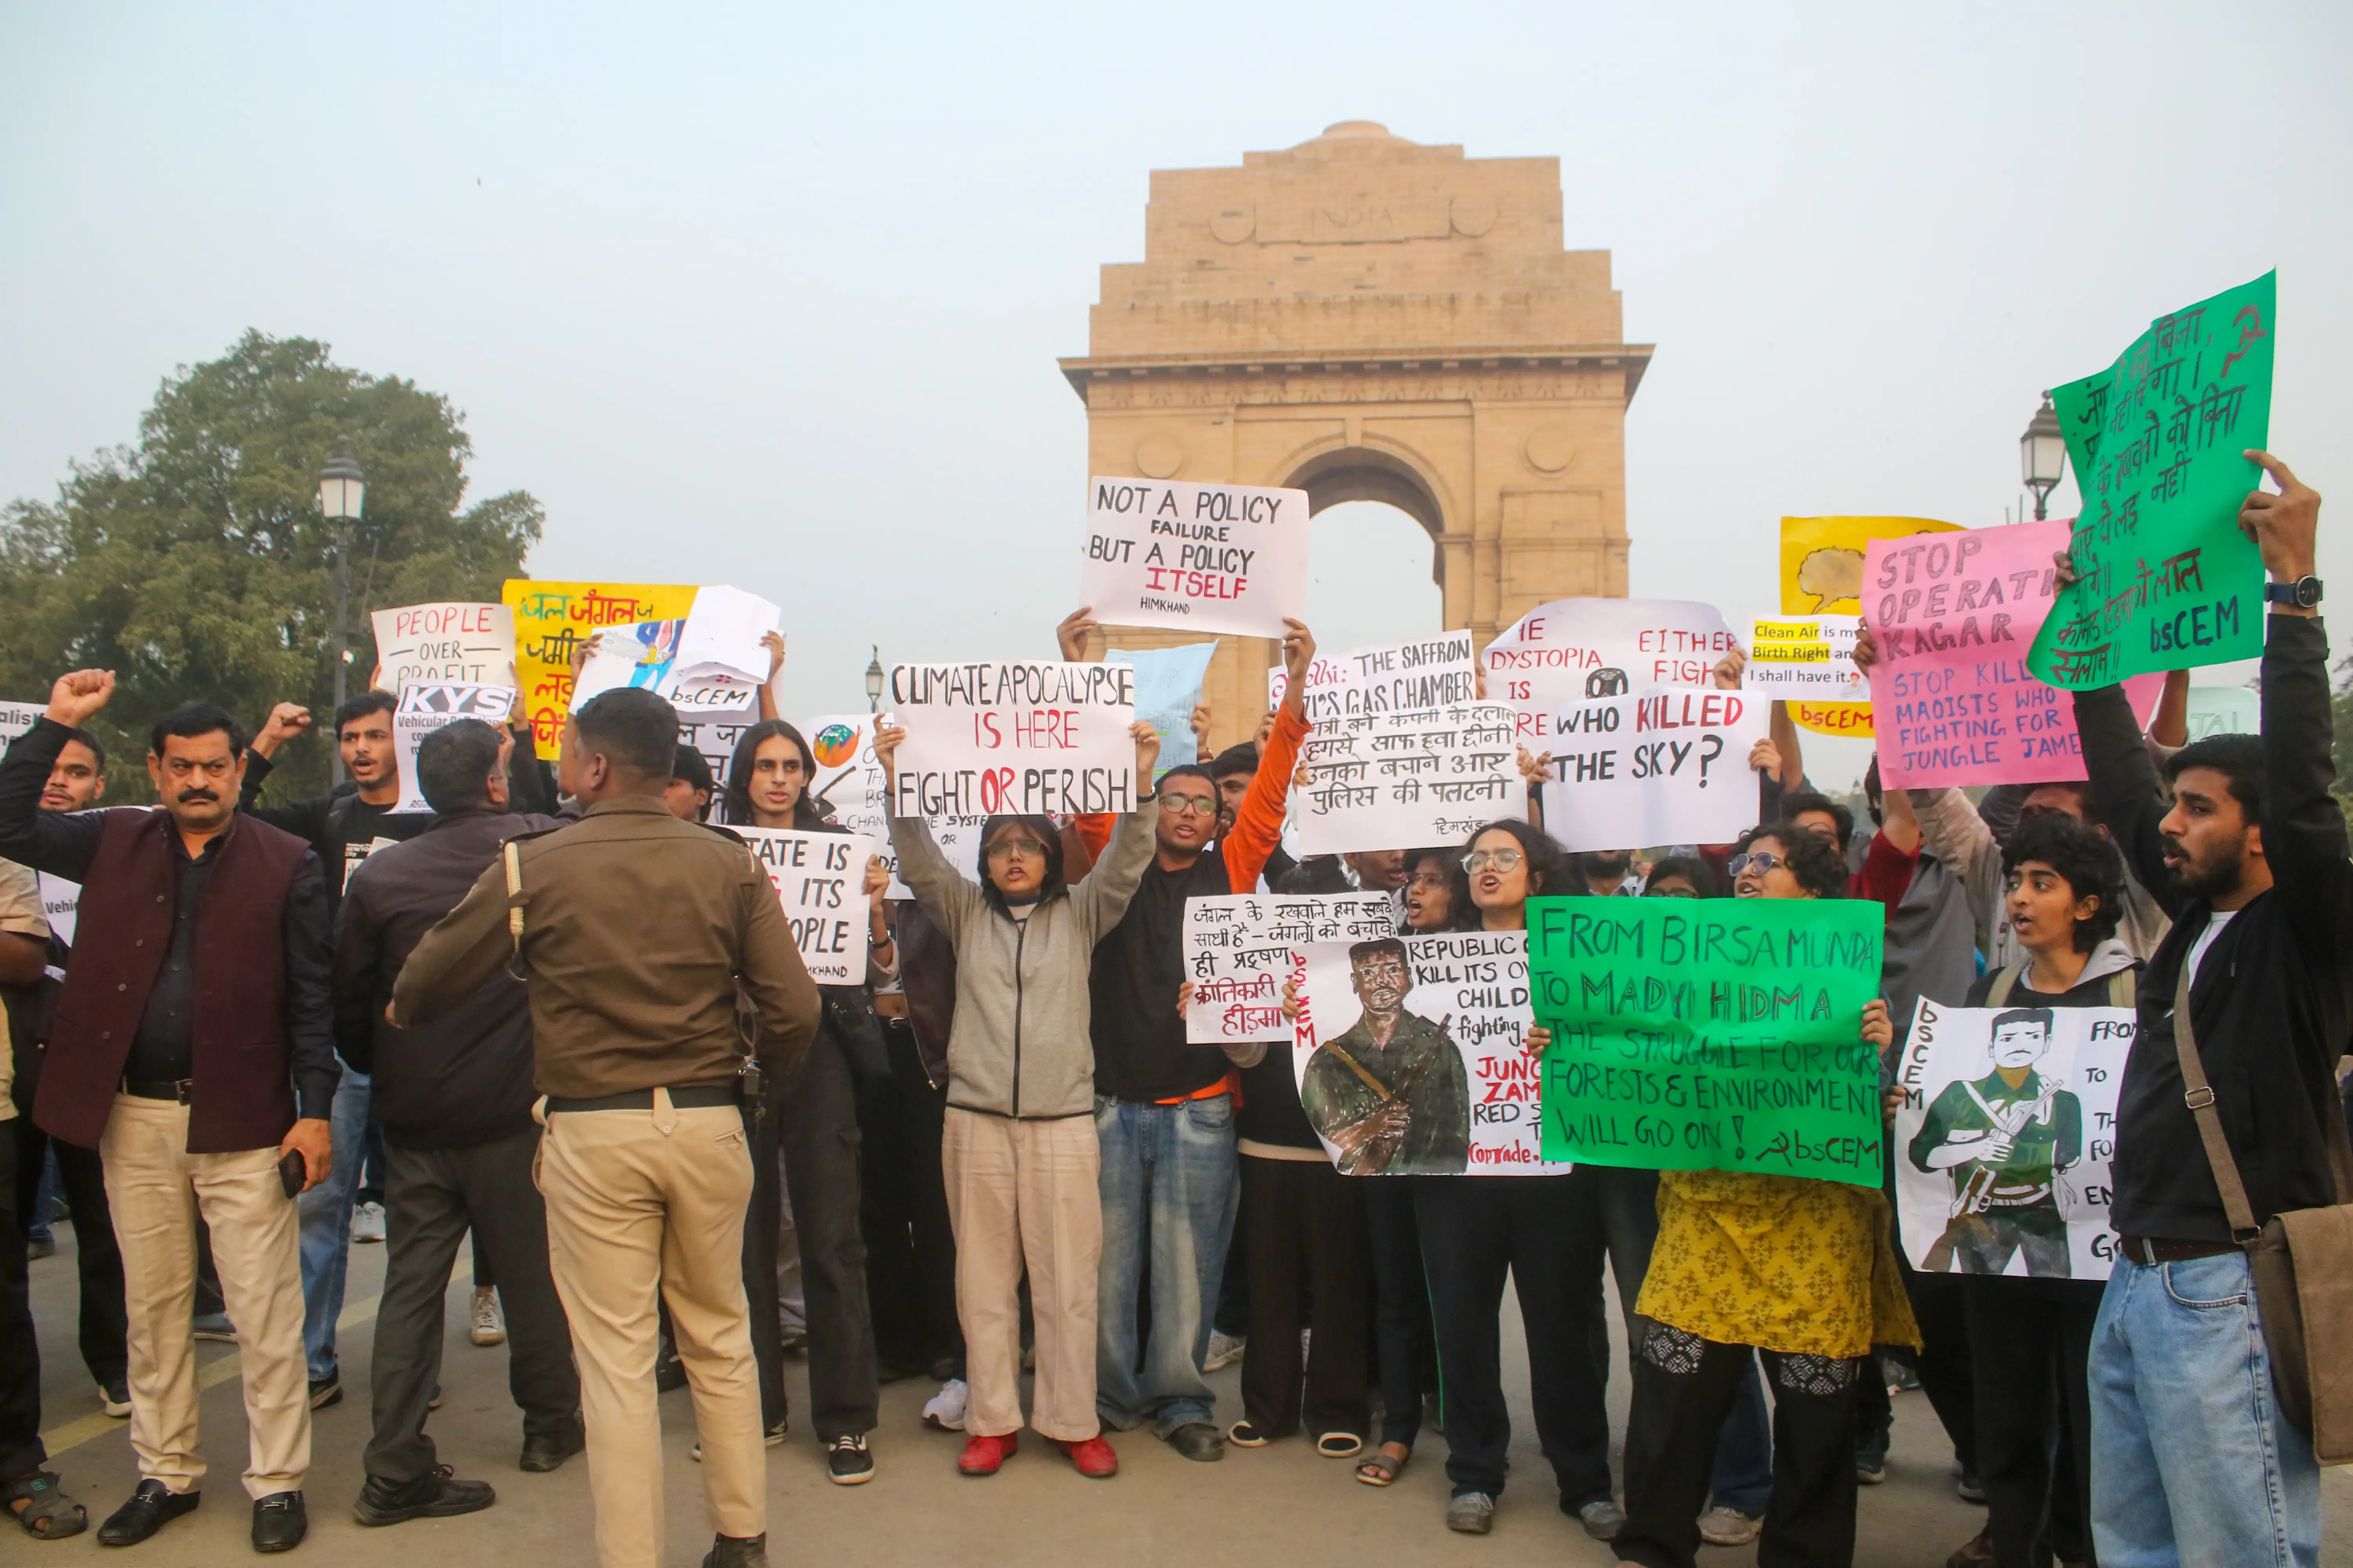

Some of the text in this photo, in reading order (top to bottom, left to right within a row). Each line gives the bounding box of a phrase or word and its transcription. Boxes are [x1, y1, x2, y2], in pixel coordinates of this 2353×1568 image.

[1097, 484, 1282, 524] NOT A POLICY
[1150, 519, 1230, 542] FAILURE
[1089, 535, 1255, 576] BUT A POLICY
[1877, 536, 1982, 589] STOP
[1145, 567, 1247, 600] ITSELF
[1878, 568, 2055, 628] OPERATI
[522, 593, 573, 621] जल
[570, 589, 640, 625] जंगल
[1140, 596, 1190, 615] HIMKHAND
[396, 606, 494, 638] PEOPLE
[1755, 625, 1794, 638] Clean
[1799, 627, 1819, 638] Air
[1824, 626, 1835, 637] is
[1883, 612, 2015, 661] KAGAR
[2150, 595, 2239, 653] bsCEM
[419, 640, 463, 660] OVER
[526, 627, 585, 665] जमी
[1639, 629, 1736, 653] EITHER
[1753, 647, 1852, 661] Birth Right an
[1353, 649, 1397, 678] THE
[1401, 638, 1471, 669] SAFFRON
[1491, 647, 1604, 670] DYSTOPIA
[1654, 660, 1713, 686] FIGH
[892, 664, 1135, 707] CLIMATE APOCALYPSE
[1508, 681, 1531, 700] IS
[1751, 669, 1850, 682] I shall have it.
[1895, 658, 2035, 698] STOP KILL
[402, 685, 509, 717] KYS
[669, 685, 748, 705] bsCEM
[1346, 685, 1389, 715] GAS
[1393, 671, 1474, 710] CHAMBER
[1896, 686, 2056, 725] MAOISTS WHO
[398, 715, 448, 728] Vehicular
[975, 709, 1080, 749] IS HERE
[1346, 712, 1380, 732] बने
[1388, 708, 1441, 728] कंपनी
[1447, 706, 1469, 725] के
[1556, 694, 1744, 735] WHO KILLED
[1800, 705, 1873, 729] bsCEM
[1900, 709, 2062, 747] FIGHTING FOR
[1306, 732, 1360, 762] हमसे
[1371, 732, 1417, 752] साफ
[1420, 731, 1459, 750] हवा
[1903, 732, 2083, 771] JUNGLE JAME
[1377, 750, 1442, 777] बचाने
[1551, 750, 1617, 783] THE
[898, 767, 1129, 817] FIGHT OR PERISH
[1308, 781, 1379, 815] पुलिस
[1392, 777, 1423, 805] की
[847, 814, 884, 829] CHAN
[946, 816, 987, 827] SYSTE
[746, 837, 809, 867] TATE
[825, 843, 851, 871] IS
[941, 834, 956, 845] OR
[800, 878, 845, 909] ITS
[1194, 904, 1237, 924] जंगल
[1245, 900, 1263, 922] के
[1334, 901, 1358, 918] हम
[1318, 918, 1341, 938] को
[786, 917, 849, 953] OPLE
[1409, 937, 1517, 963] REPUBLIC
[1542, 908, 1875, 972] FROM BIRSA MUNDA
[1191, 950, 1219, 978] ही
[1416, 966, 1461, 985] KILL
[1464, 961, 1497, 983] ITS
[1457, 987, 1529, 1009] CHILD
[1535, 970, 1569, 1007] TO
[1710, 981, 1832, 1023] HIDMA
[1548, 1017, 1604, 1051] THE
[1759, 1037, 1829, 1074] FOR
[1834, 1041, 1878, 1079] OUR
[1475, 1056, 1541, 1081] JUNG
[2085, 1068, 2107, 1083] TO
[1482, 1081, 1541, 1104] ZAM
[1549, 1058, 1659, 1106] FORESTS
[1695, 1074, 1880, 1125] ENVIRONMENT
[1474, 1103, 1520, 1126] RED
[1557, 1106, 1629, 1147] WILL
[1635, 1115, 1674, 1149] GO
[1684, 1120, 1722, 1151] ON
[1795, 1129, 1881, 1170] bsCEM
